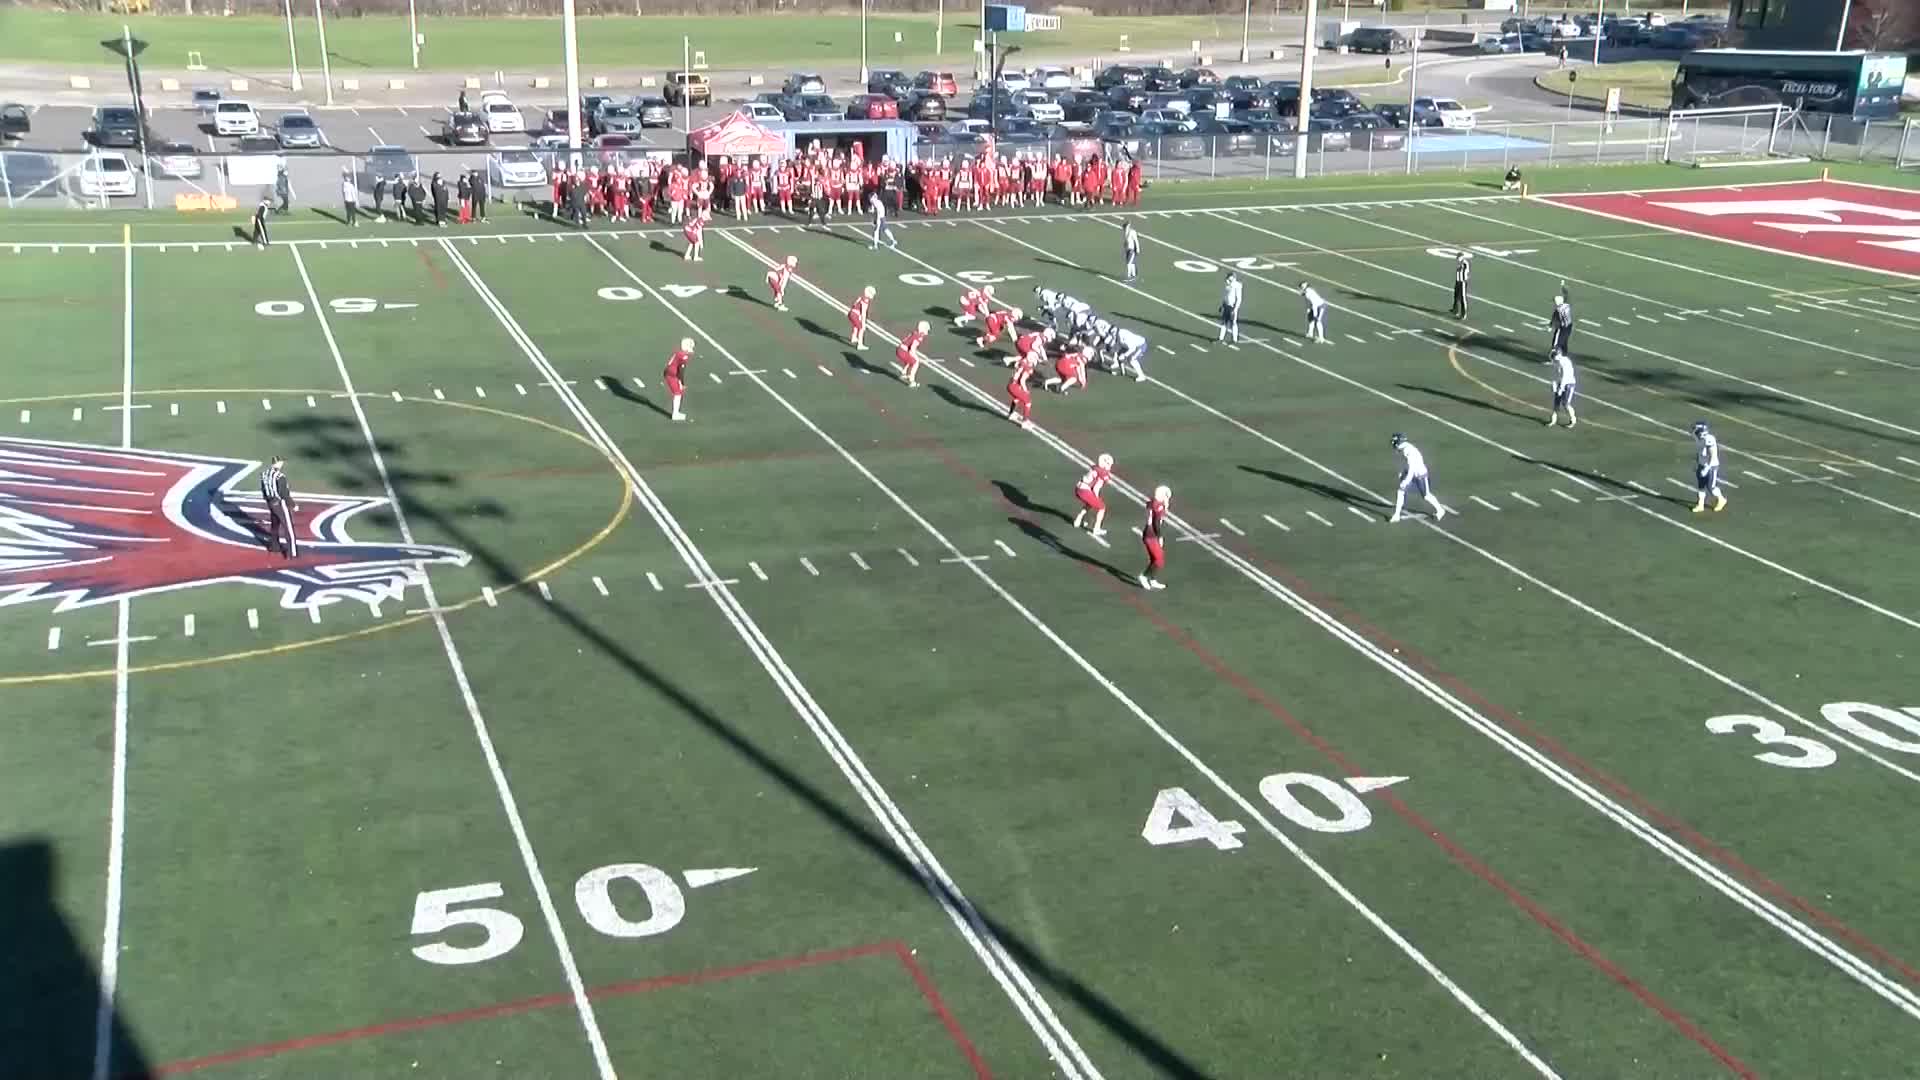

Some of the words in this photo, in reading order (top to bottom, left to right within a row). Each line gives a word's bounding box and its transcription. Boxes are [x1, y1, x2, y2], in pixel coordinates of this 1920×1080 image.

[1173, 257, 1275, 272] 20
[898, 270, 1005, 286] 30
[597, 284, 708, 298] 40
[254, 297, 378, 315] 50
[1705, 701, 1920, 768] 30
[1142, 772, 1372, 850] 40
[411, 863, 686, 965] 50
